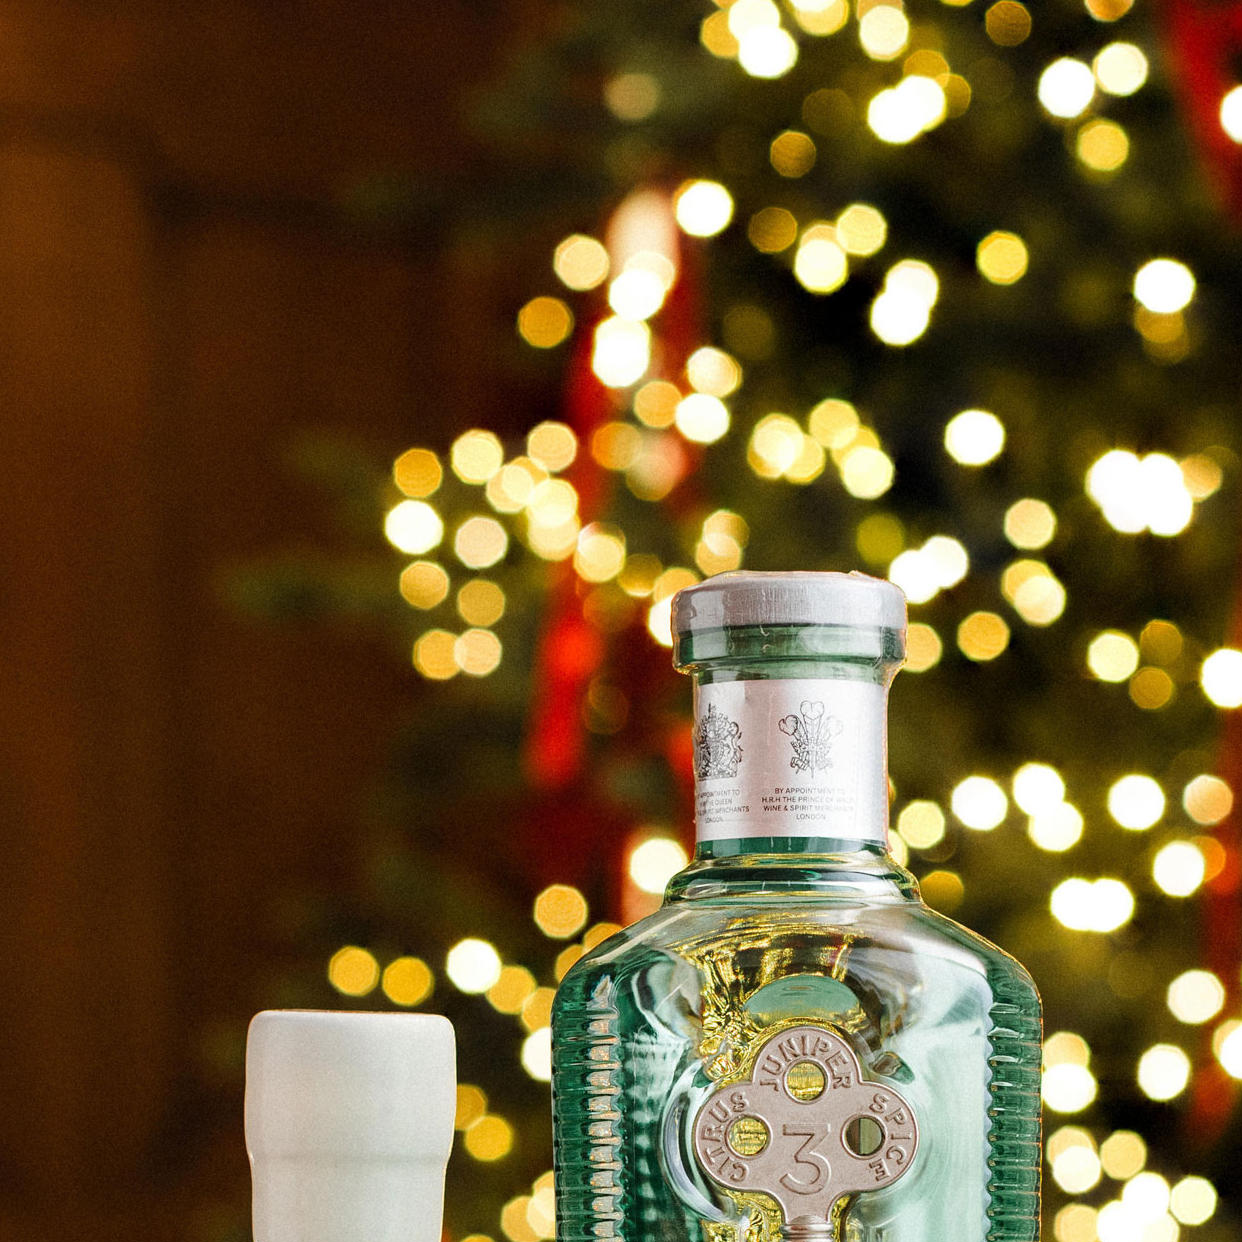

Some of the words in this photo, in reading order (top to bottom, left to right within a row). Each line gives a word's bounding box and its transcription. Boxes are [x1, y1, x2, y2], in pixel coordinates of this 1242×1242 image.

[759, 1035, 853, 1092] JUNIPER
[702, 1091, 750, 1183] CITRUS
[779, 1123, 832, 1196] 3
[868, 1092, 913, 1182] SPICE
